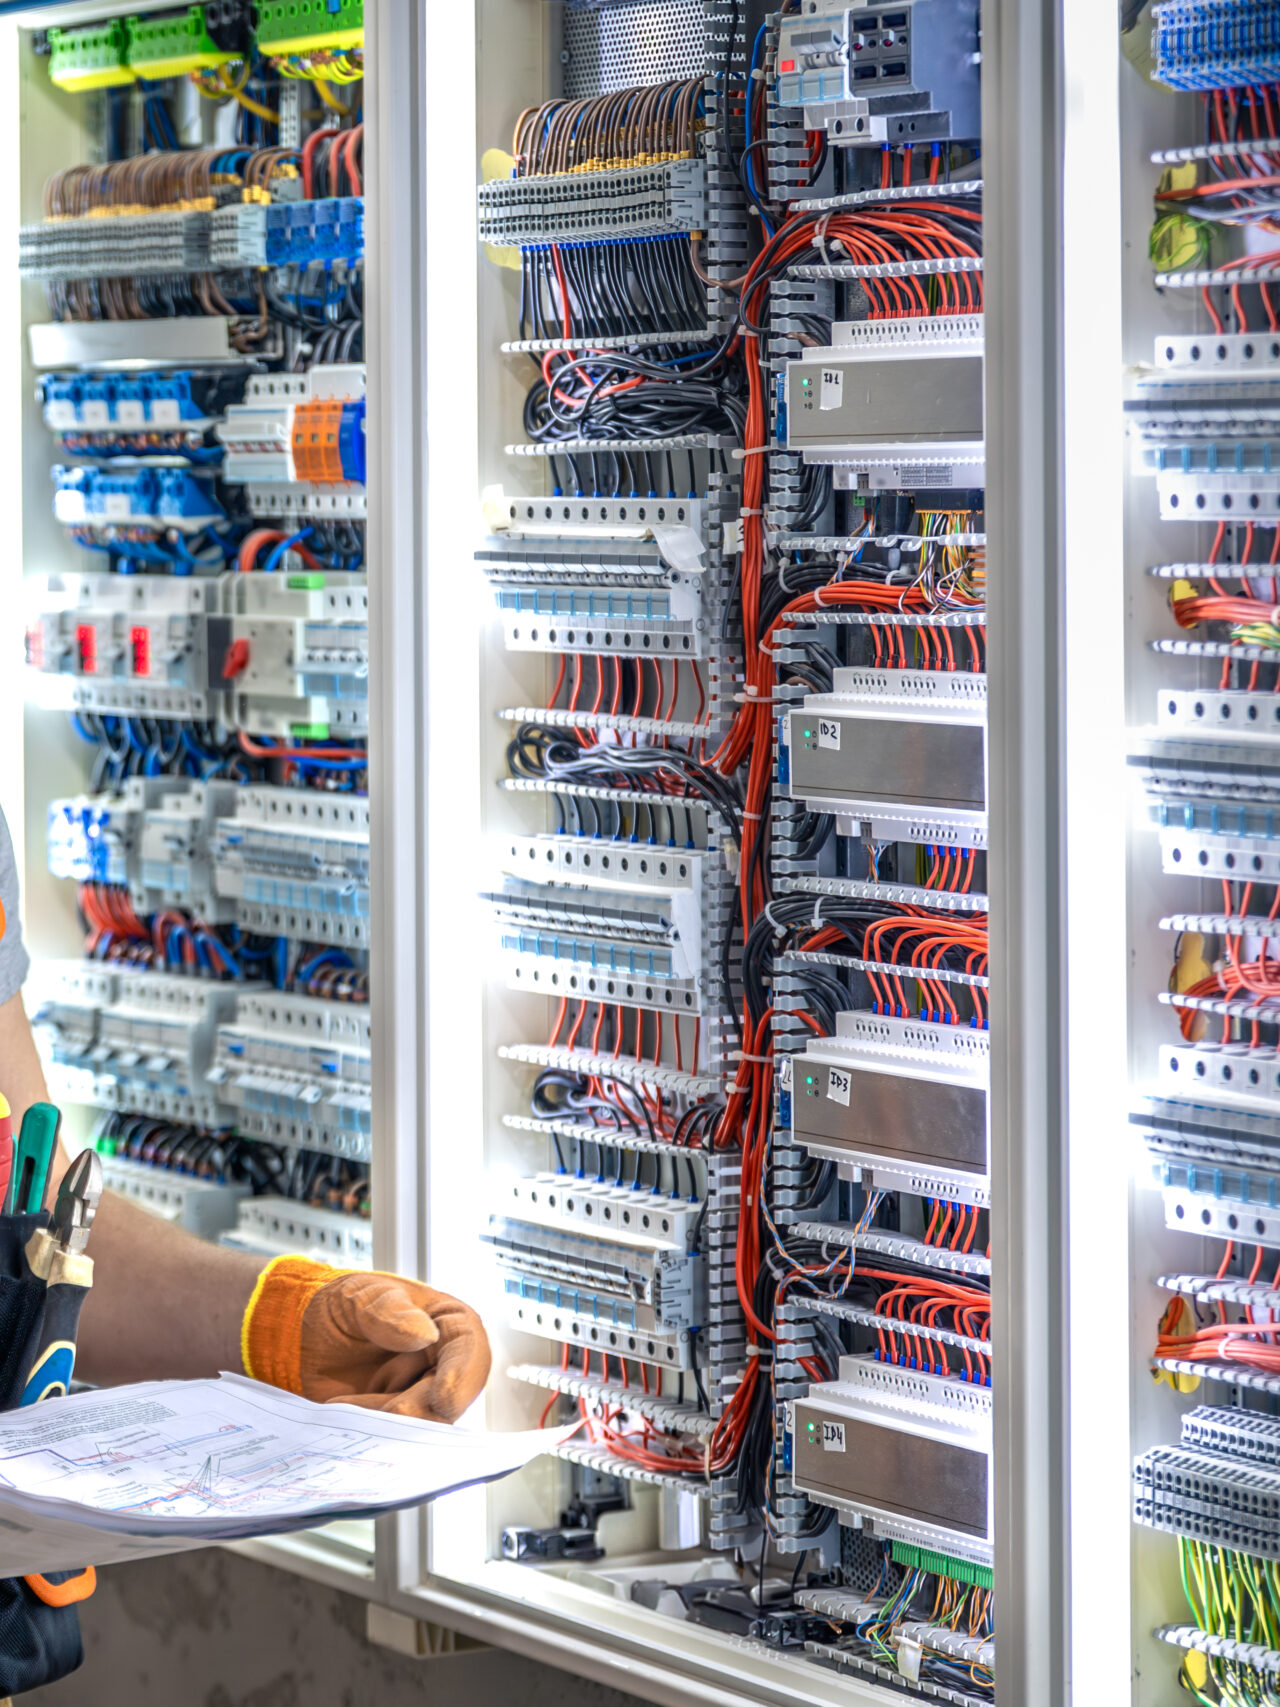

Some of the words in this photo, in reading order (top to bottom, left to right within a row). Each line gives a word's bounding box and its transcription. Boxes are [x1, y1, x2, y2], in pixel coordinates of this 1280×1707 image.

[824, 373, 840, 385] ID1
[820, 722, 838, 740] ID2
[830, 1071, 848, 1092] ID3
[824, 1424, 844, 1446] ID4
